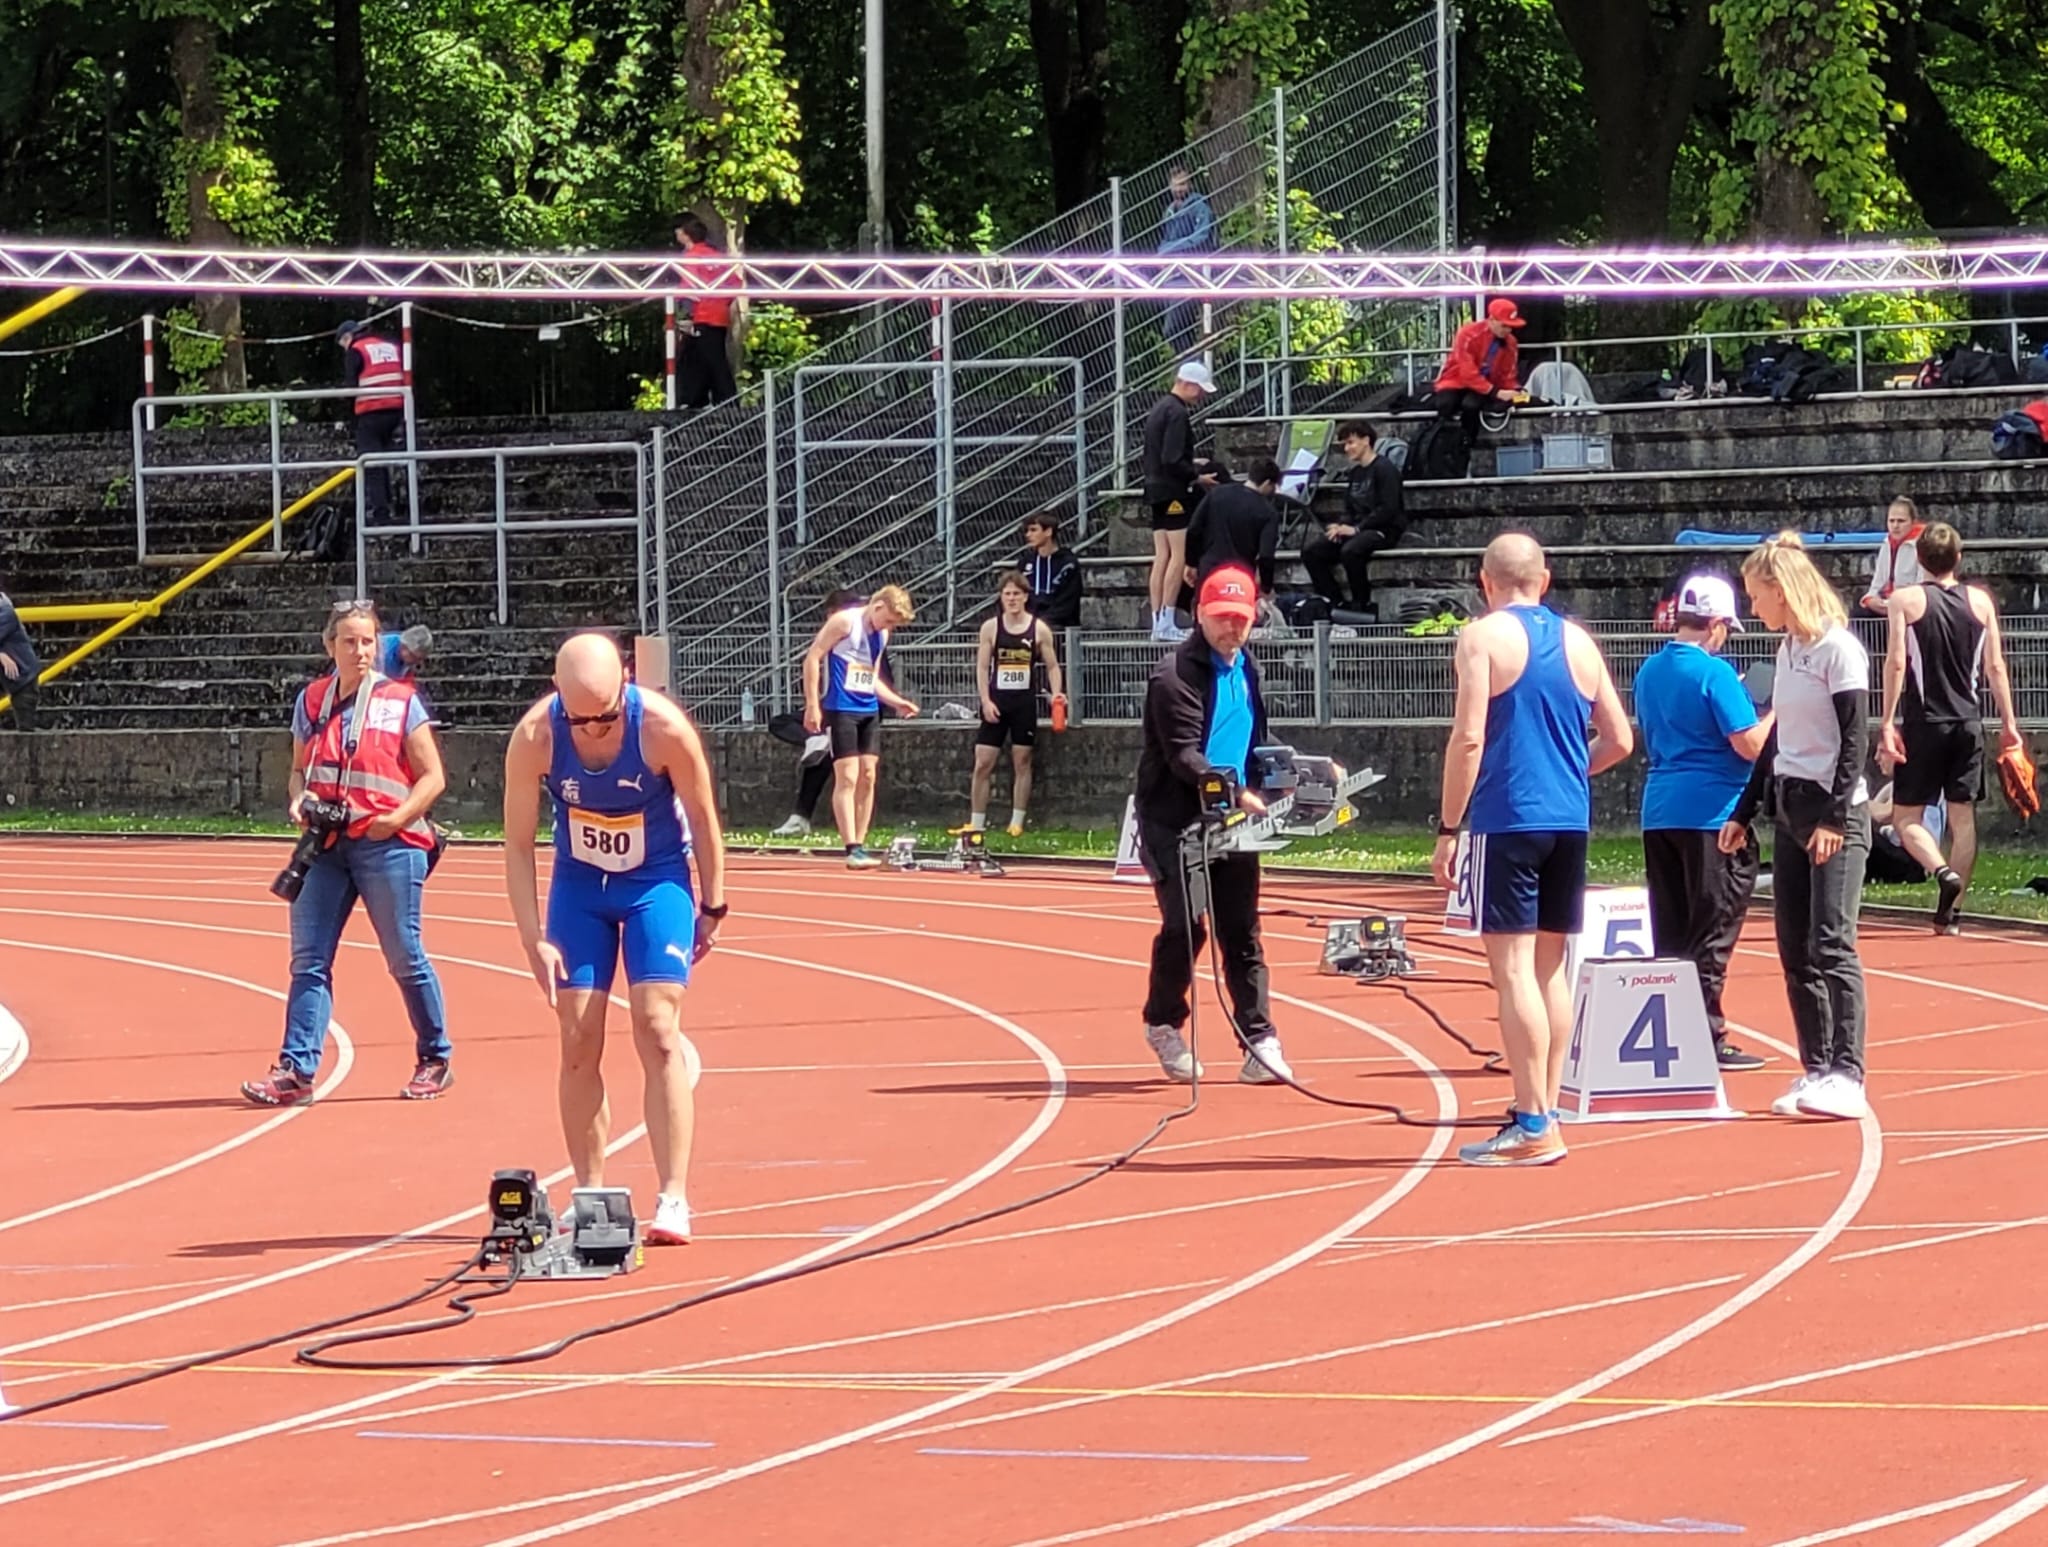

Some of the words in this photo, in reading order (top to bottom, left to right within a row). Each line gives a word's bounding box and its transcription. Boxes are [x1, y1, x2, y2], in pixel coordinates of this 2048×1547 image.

[1003, 671, 1025, 682] 288
[582, 825, 631, 856] 580
[1603, 918, 1646, 956] 5
[1631, 973, 1677, 988] polanik
[1619, 993, 1681, 1079] 4
